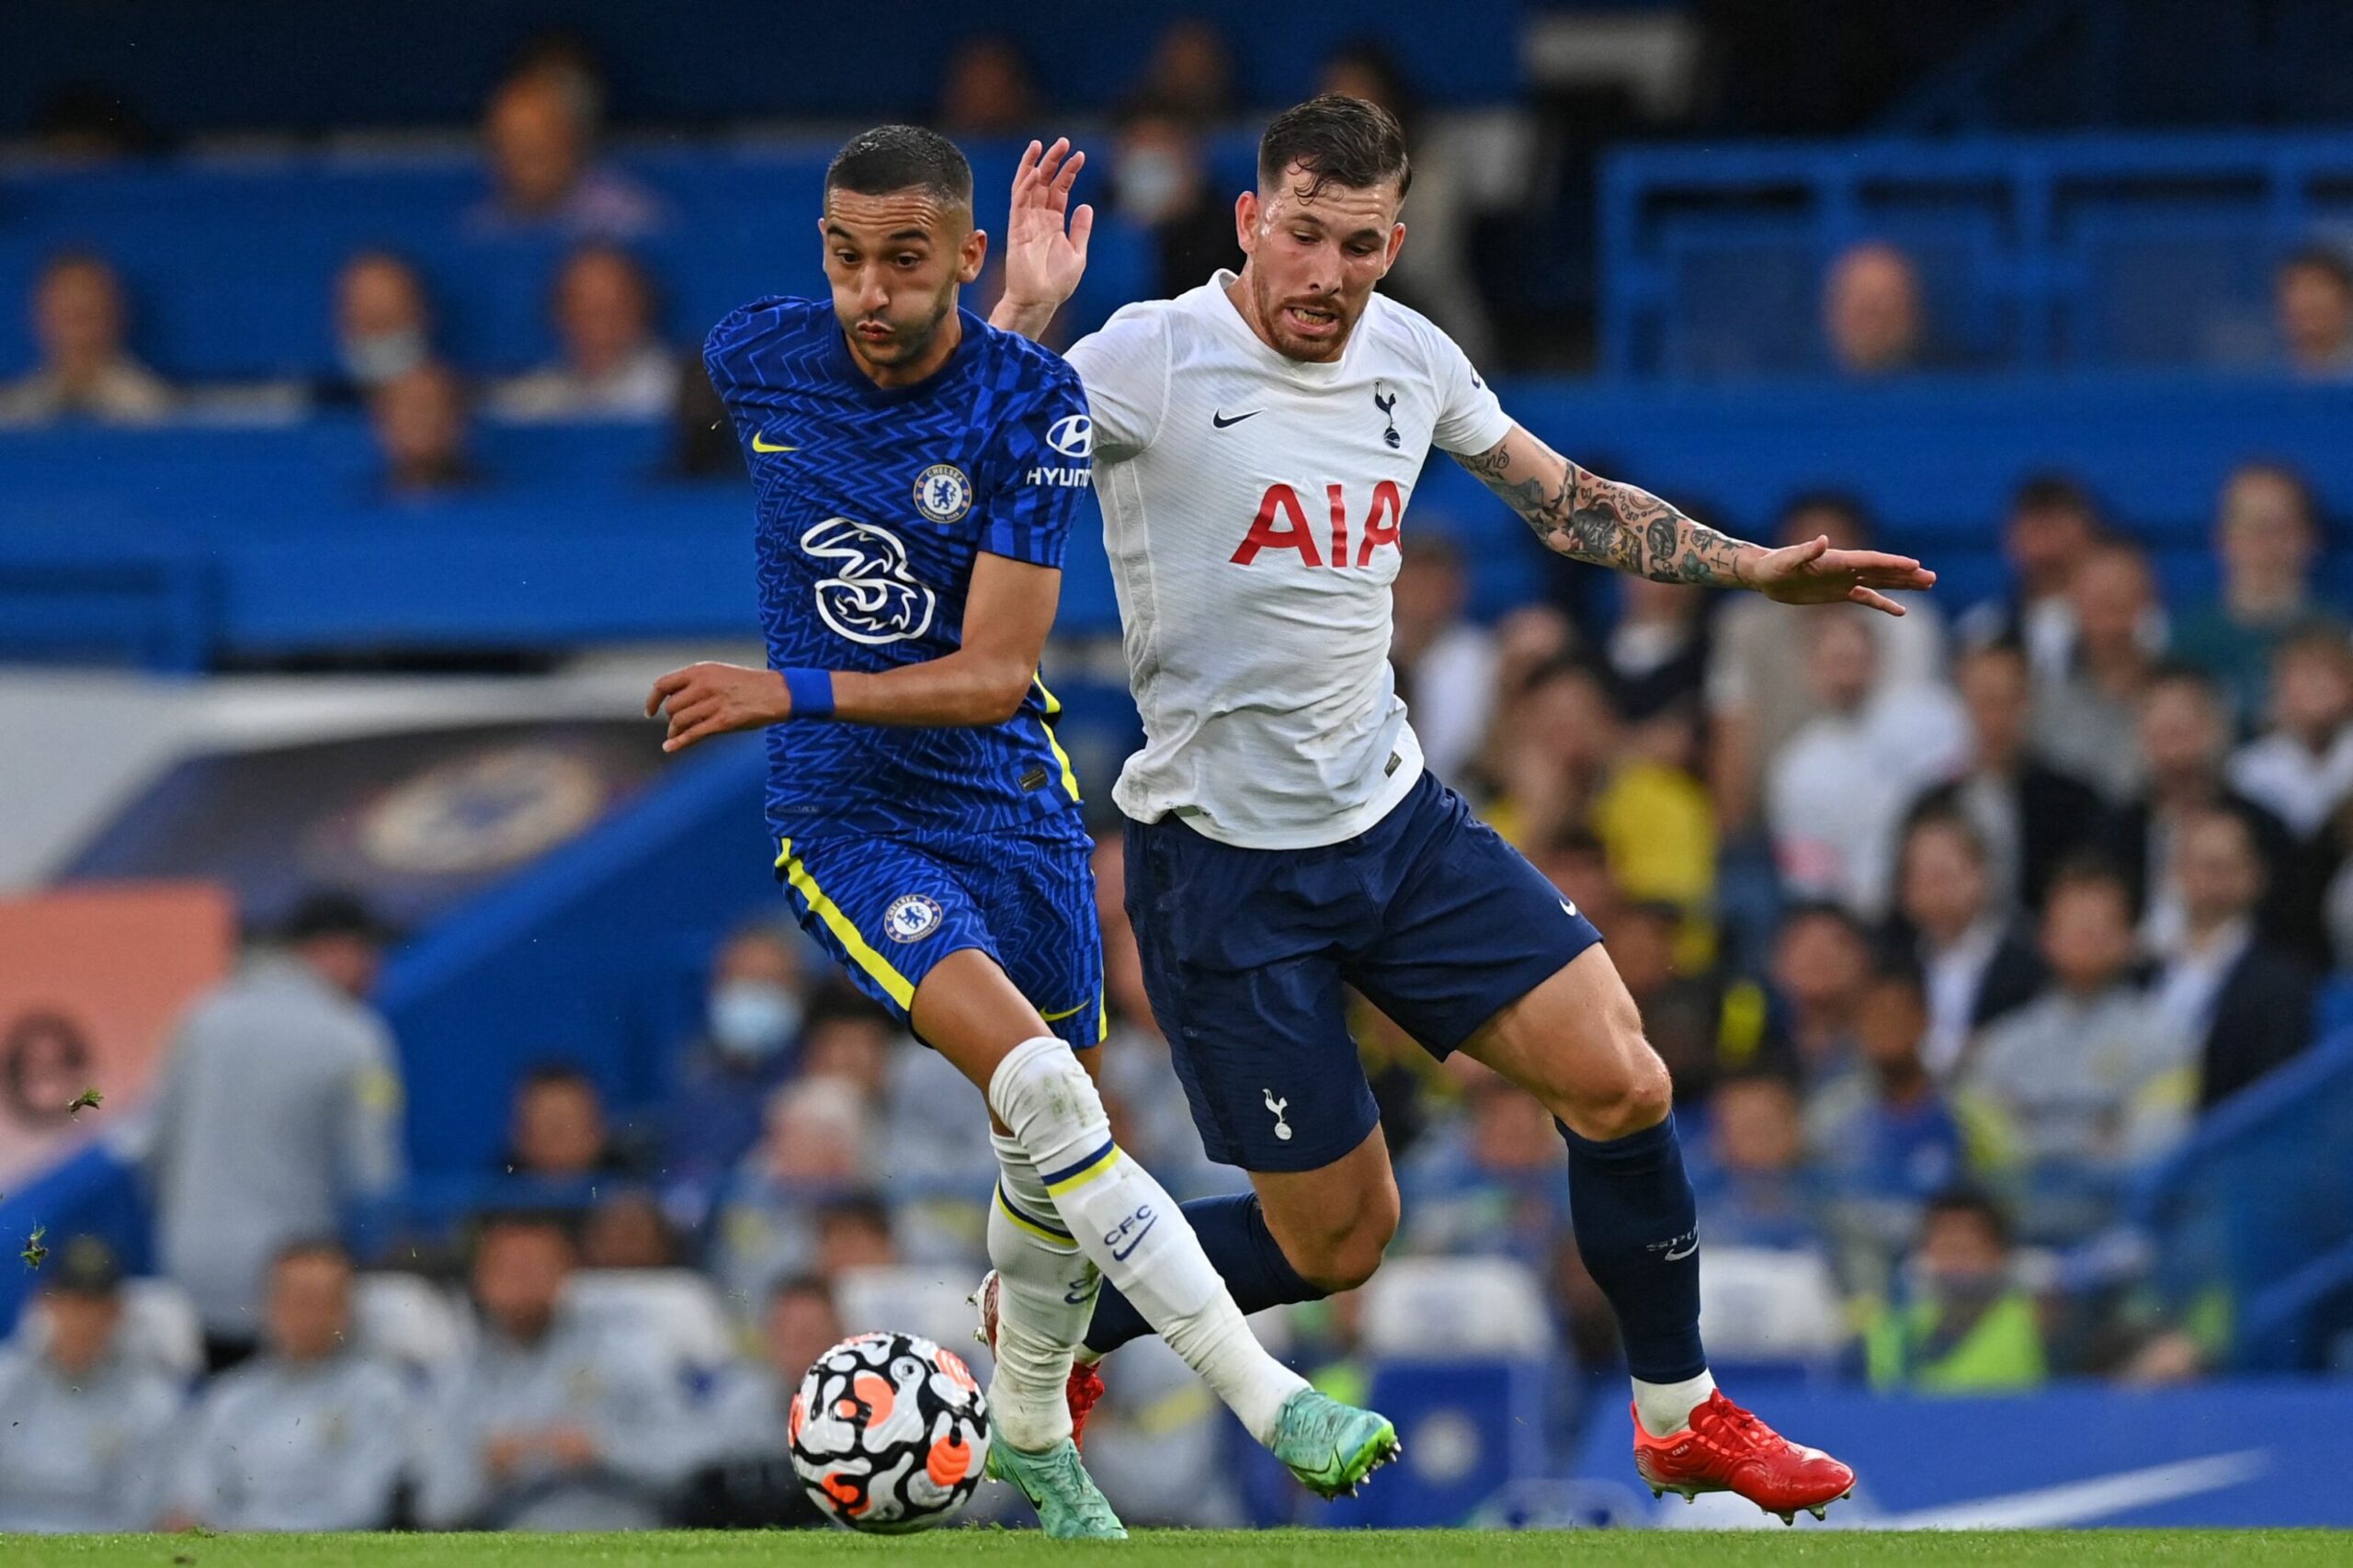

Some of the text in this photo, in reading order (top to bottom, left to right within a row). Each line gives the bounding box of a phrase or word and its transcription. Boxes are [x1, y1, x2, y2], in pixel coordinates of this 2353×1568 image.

[926, 466, 963, 483] CHELSEA
[1228, 480, 1403, 568] AIA
[887, 895, 917, 921] CHELSEA
[1104, 1204, 1153, 1245] CFC
